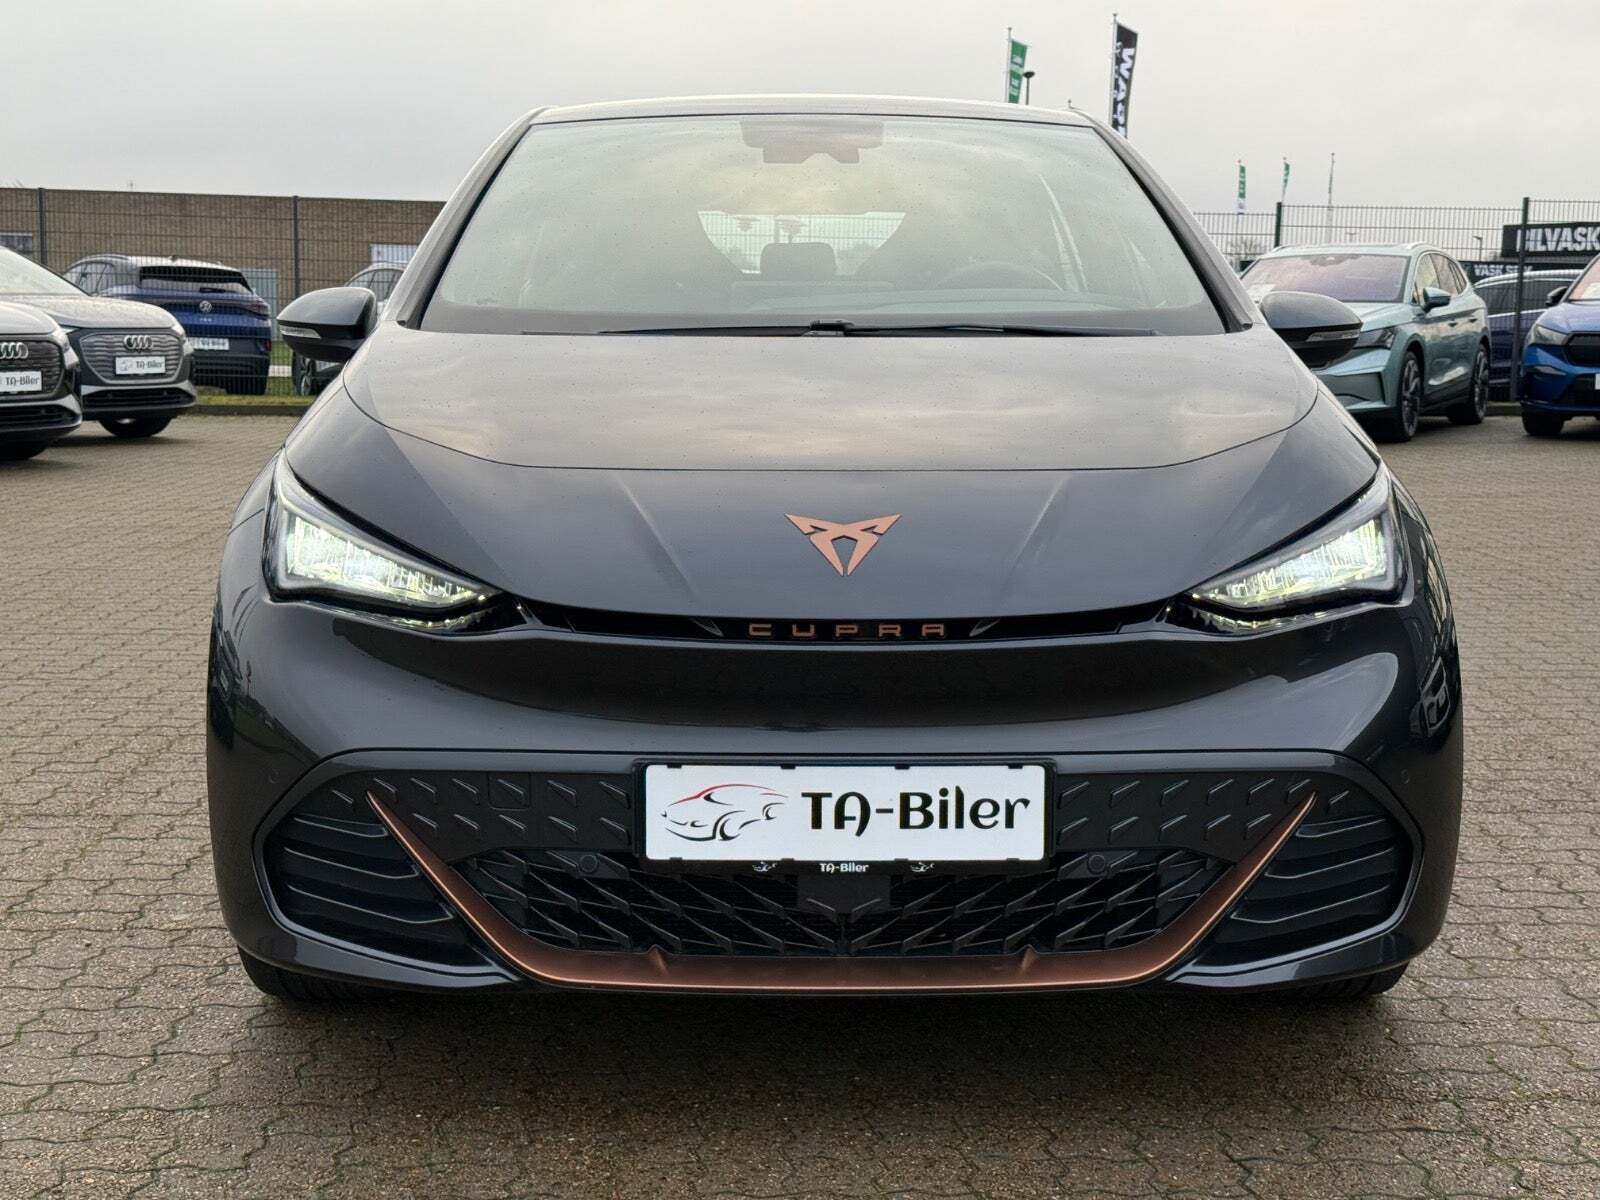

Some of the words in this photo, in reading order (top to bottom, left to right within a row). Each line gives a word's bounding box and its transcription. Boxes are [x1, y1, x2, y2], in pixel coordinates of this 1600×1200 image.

[749, 623, 945, 638] CUPRA
[801, 785, 1031, 837] TA-Biler
[819, 862, 869, 873] TA-Biler
